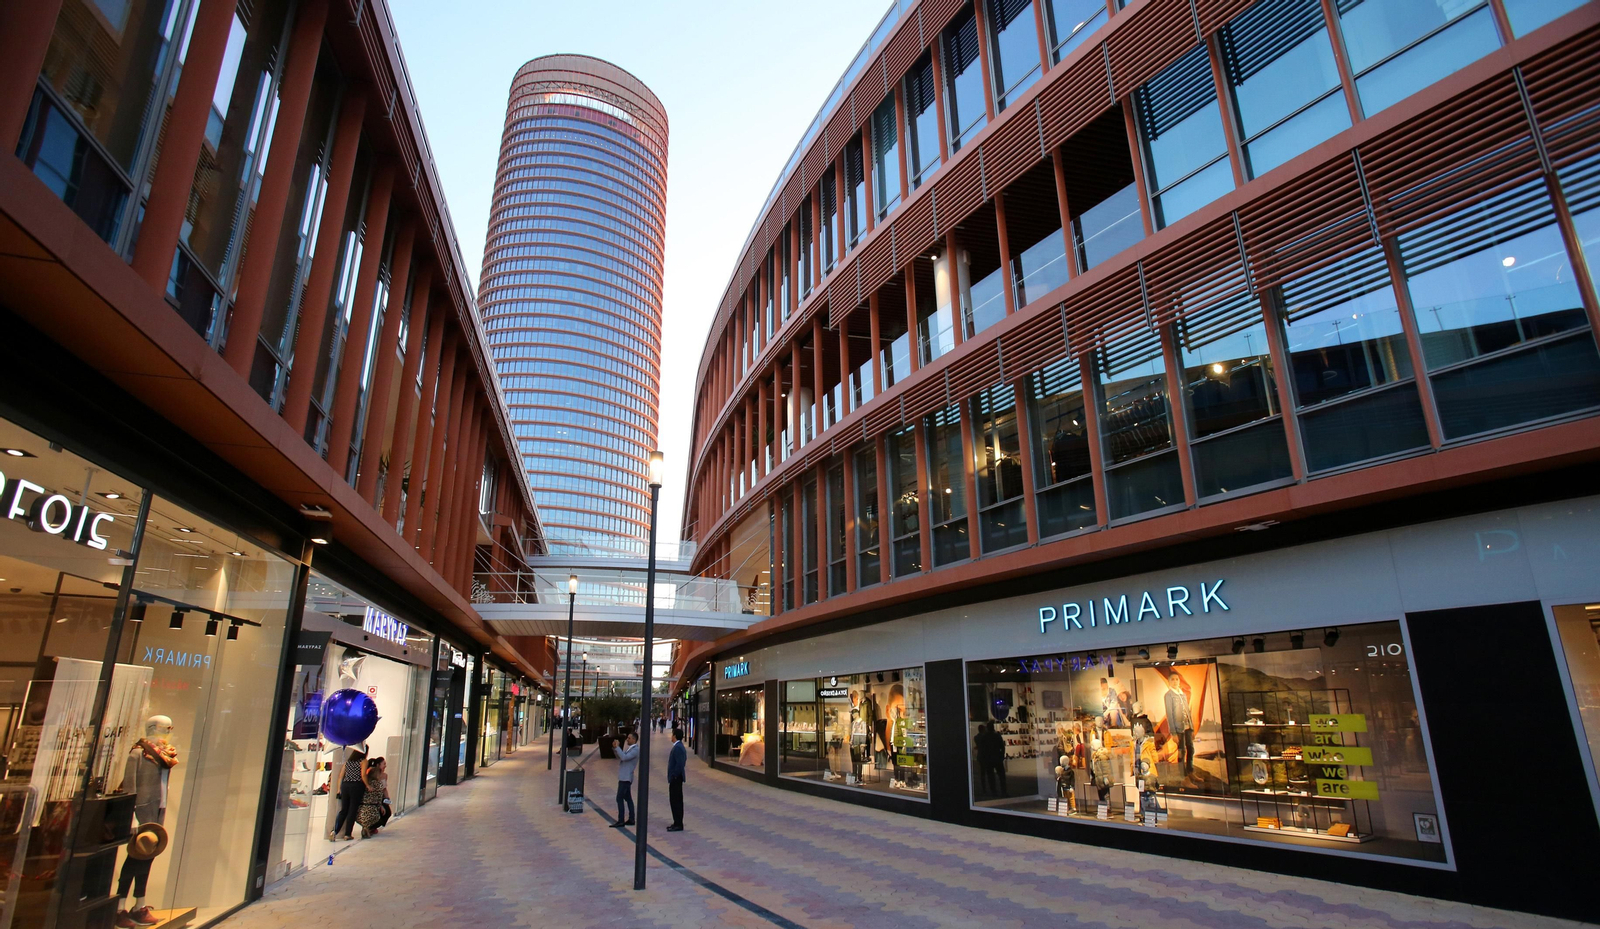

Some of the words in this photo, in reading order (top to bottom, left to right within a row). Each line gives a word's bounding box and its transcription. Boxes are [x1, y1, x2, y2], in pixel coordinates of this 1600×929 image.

[0, 471, 114, 550] FOIS
[1038, 579, 1230, 633] PRIMARK
[363, 606, 409, 646] MARYPAZ
[724, 661, 750, 679] PRIMARK
[1315, 717, 1339, 728] we
[1314, 733, 1342, 745] are
[1308, 748, 1345, 762] who
[1322, 767, 1348, 778] we
[1322, 782, 1350, 794] are
